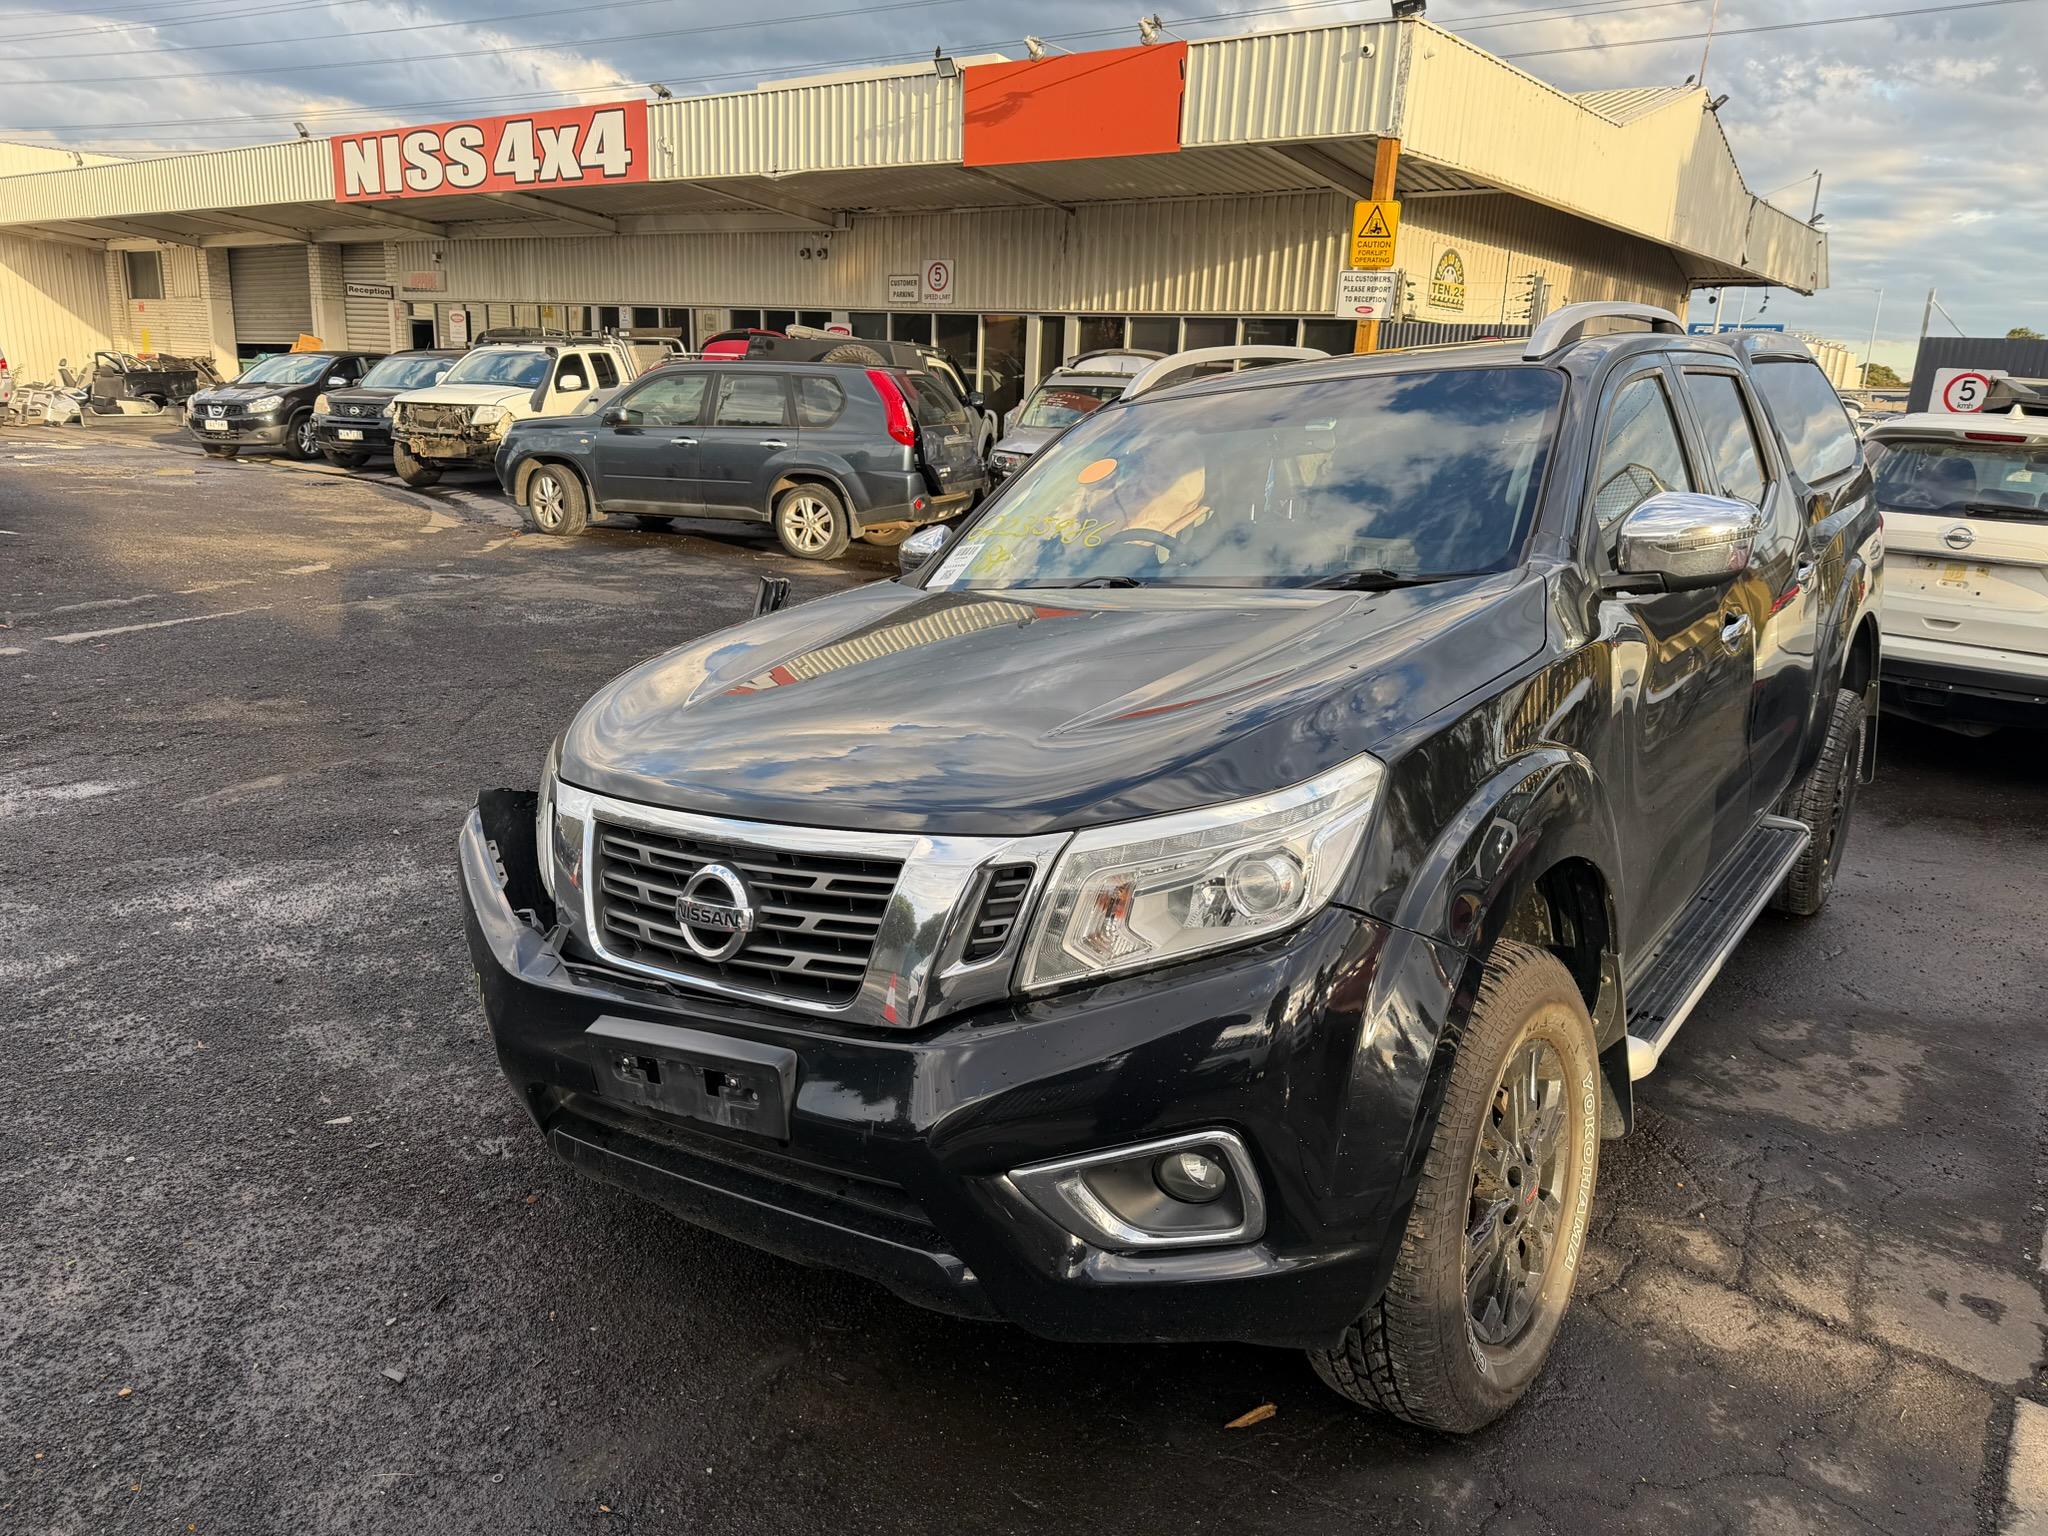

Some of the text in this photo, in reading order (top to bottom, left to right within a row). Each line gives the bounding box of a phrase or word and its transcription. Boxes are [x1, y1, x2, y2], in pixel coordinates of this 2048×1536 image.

[341, 108, 632, 196] NISS 4x4
[934, 267, 942, 282] 5
[348, 285, 391, 295] Reception
[1958, 380, 1977, 401] 5
[679, 900, 740, 928] NISSAN
[1565, 1071, 1595, 1272] YOKOHAMA
